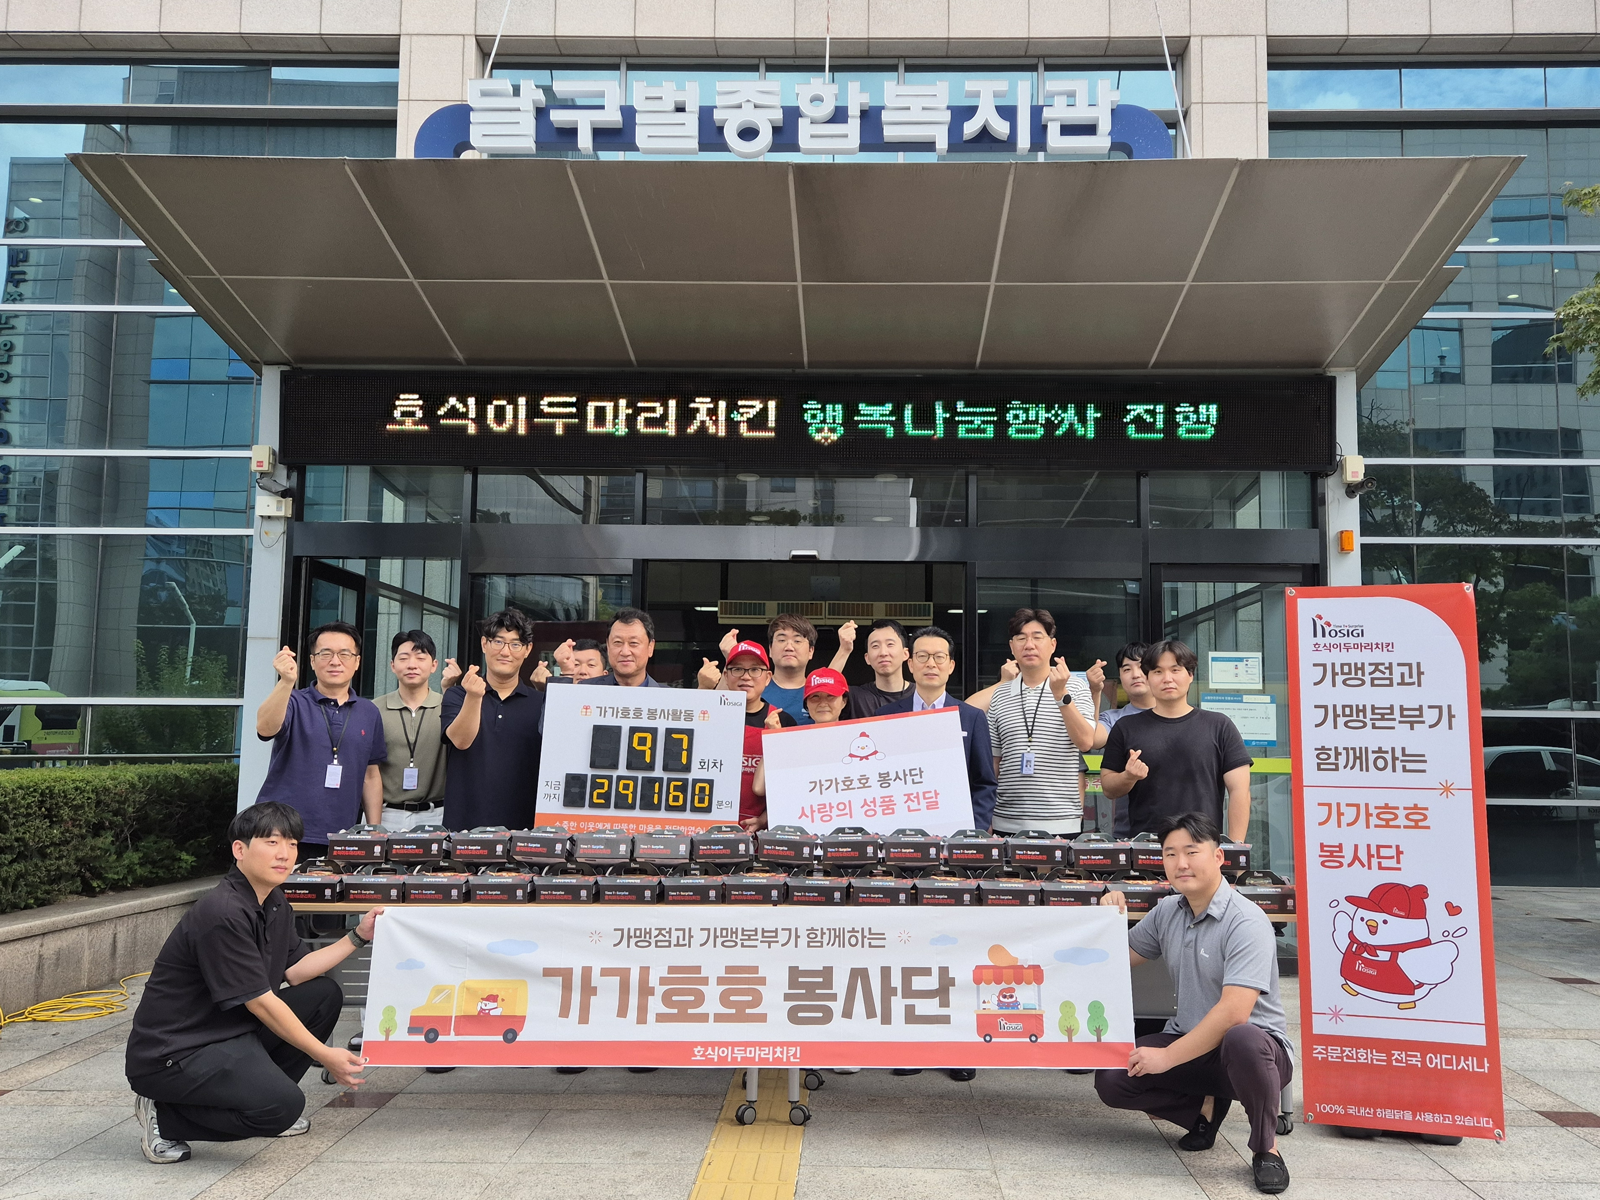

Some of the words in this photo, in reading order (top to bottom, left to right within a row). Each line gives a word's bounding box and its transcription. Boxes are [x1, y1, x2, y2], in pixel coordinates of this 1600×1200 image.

[467, 78, 1121, 158] 달구벌종합복지관
[386, 393, 777, 436] 호식이두마리치킨
[1122, 402, 1220, 439] 진행
[1312, 642, 1395, 653] 호식이두마리치킨
[1312, 662, 1425, 688] 가맹점과
[596, 706, 644, 720] 가가호호
[646, 708, 695, 722] 봉사활동
[1314, 704, 1456, 730] 가맹본부가
[698, 758, 724, 772] 회차
[1314, 746, 1428, 773] 함께하는
[544, 780, 562, 791] 지금
[592, 778, 710, 808] 29160
[716, 799, 733, 810] 분의
[808, 773, 873, 796] 가가호호
[876, 767, 925, 789] 봉사단
[543, 792, 560, 802] 까지
[798, 800, 853, 824] 사랑의
[860, 795, 897, 819] 성품
[903, 789, 941, 814] 전달
[580, 821, 611, 830] 이웃에게
[613, 822, 636, 832] 따뜻한
[1317, 802, 1431, 830] 가가호호
[1318, 842, 1404, 872] 봉사단
[612, 927, 694, 950] 가맹점과
[699, 927, 801, 950] 가맹본부가
[806, 927, 887, 950] 함께하는
[541, 965, 769, 1026] 가가호호
[782, 965, 957, 1026] 봉사단
[690, 1045, 801, 1063] 호식이두마리치킨
[1312, 1045, 1387, 1066] 주문전화는
[1391, 1050, 1422, 1067] 전국
[1426, 1053, 1490, 1073] 어디서나
[1315, 1103, 1345, 1115] 100%
[1346, 1105, 1374, 1118] 국내산
[1376, 1107, 1413, 1121] 하림닭을
[1415, 1111, 1453, 1124] 사용하고
[1454, 1114, 1494, 1128] 있습니다
